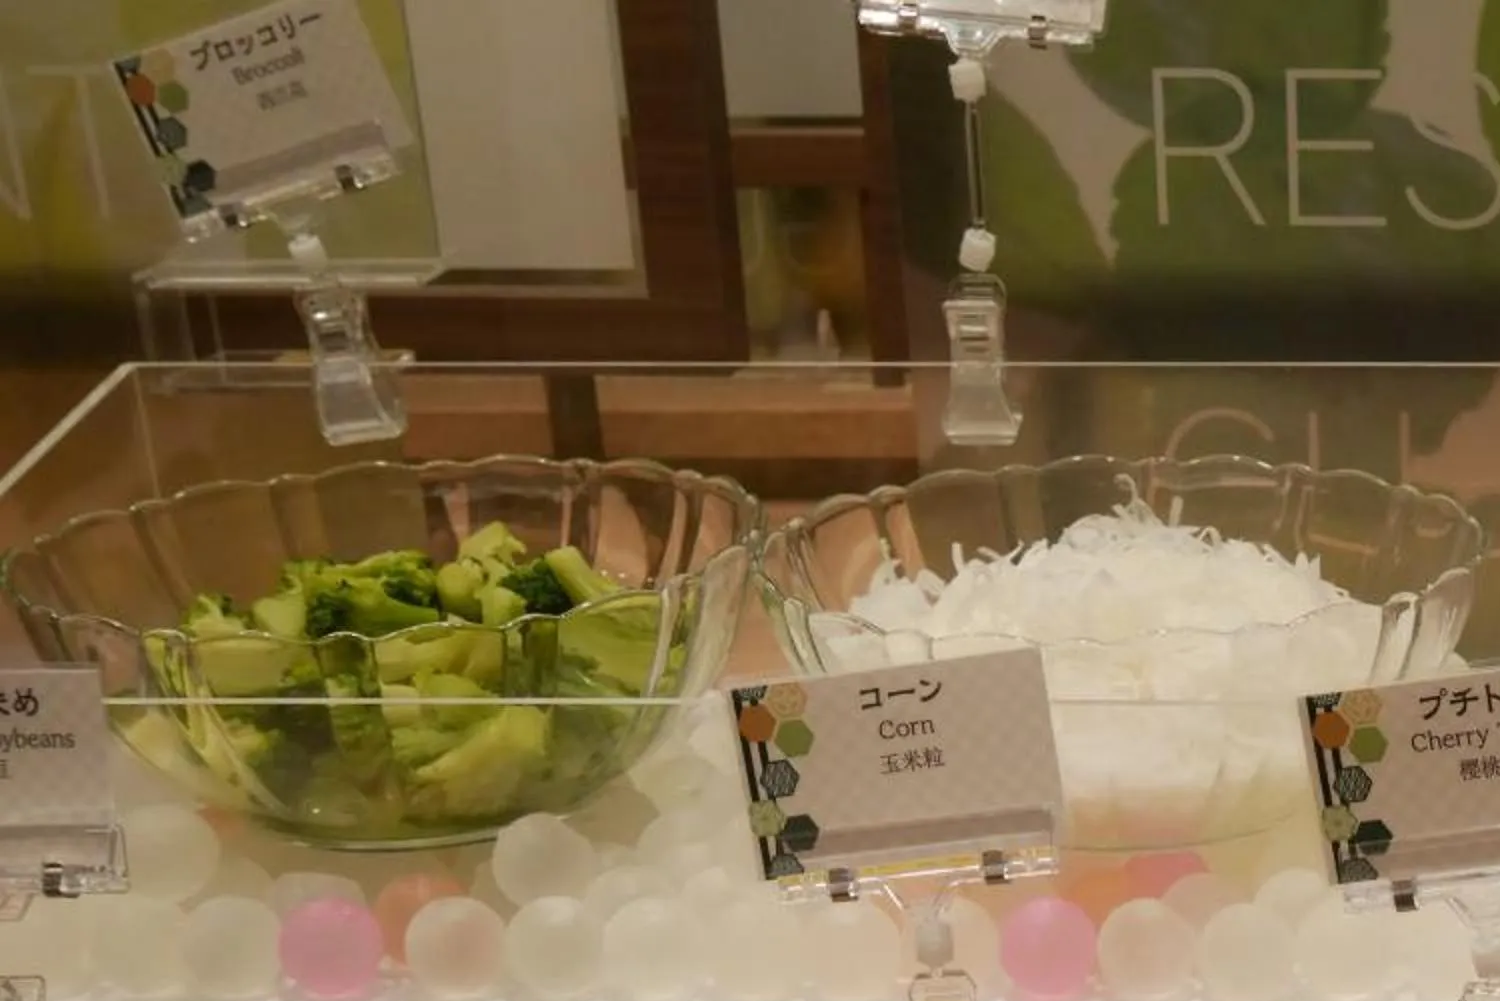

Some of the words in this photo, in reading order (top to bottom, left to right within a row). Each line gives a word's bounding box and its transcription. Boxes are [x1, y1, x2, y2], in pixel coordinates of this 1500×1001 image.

[189, 12, 322, 71] ブロッコリー
[859, 679, 942, 711] コーン
[879, 718, 935, 740] Corn
[1410, 724, 1489, 753] Cherry
[880, 748, 945, 775] 玉米粒
